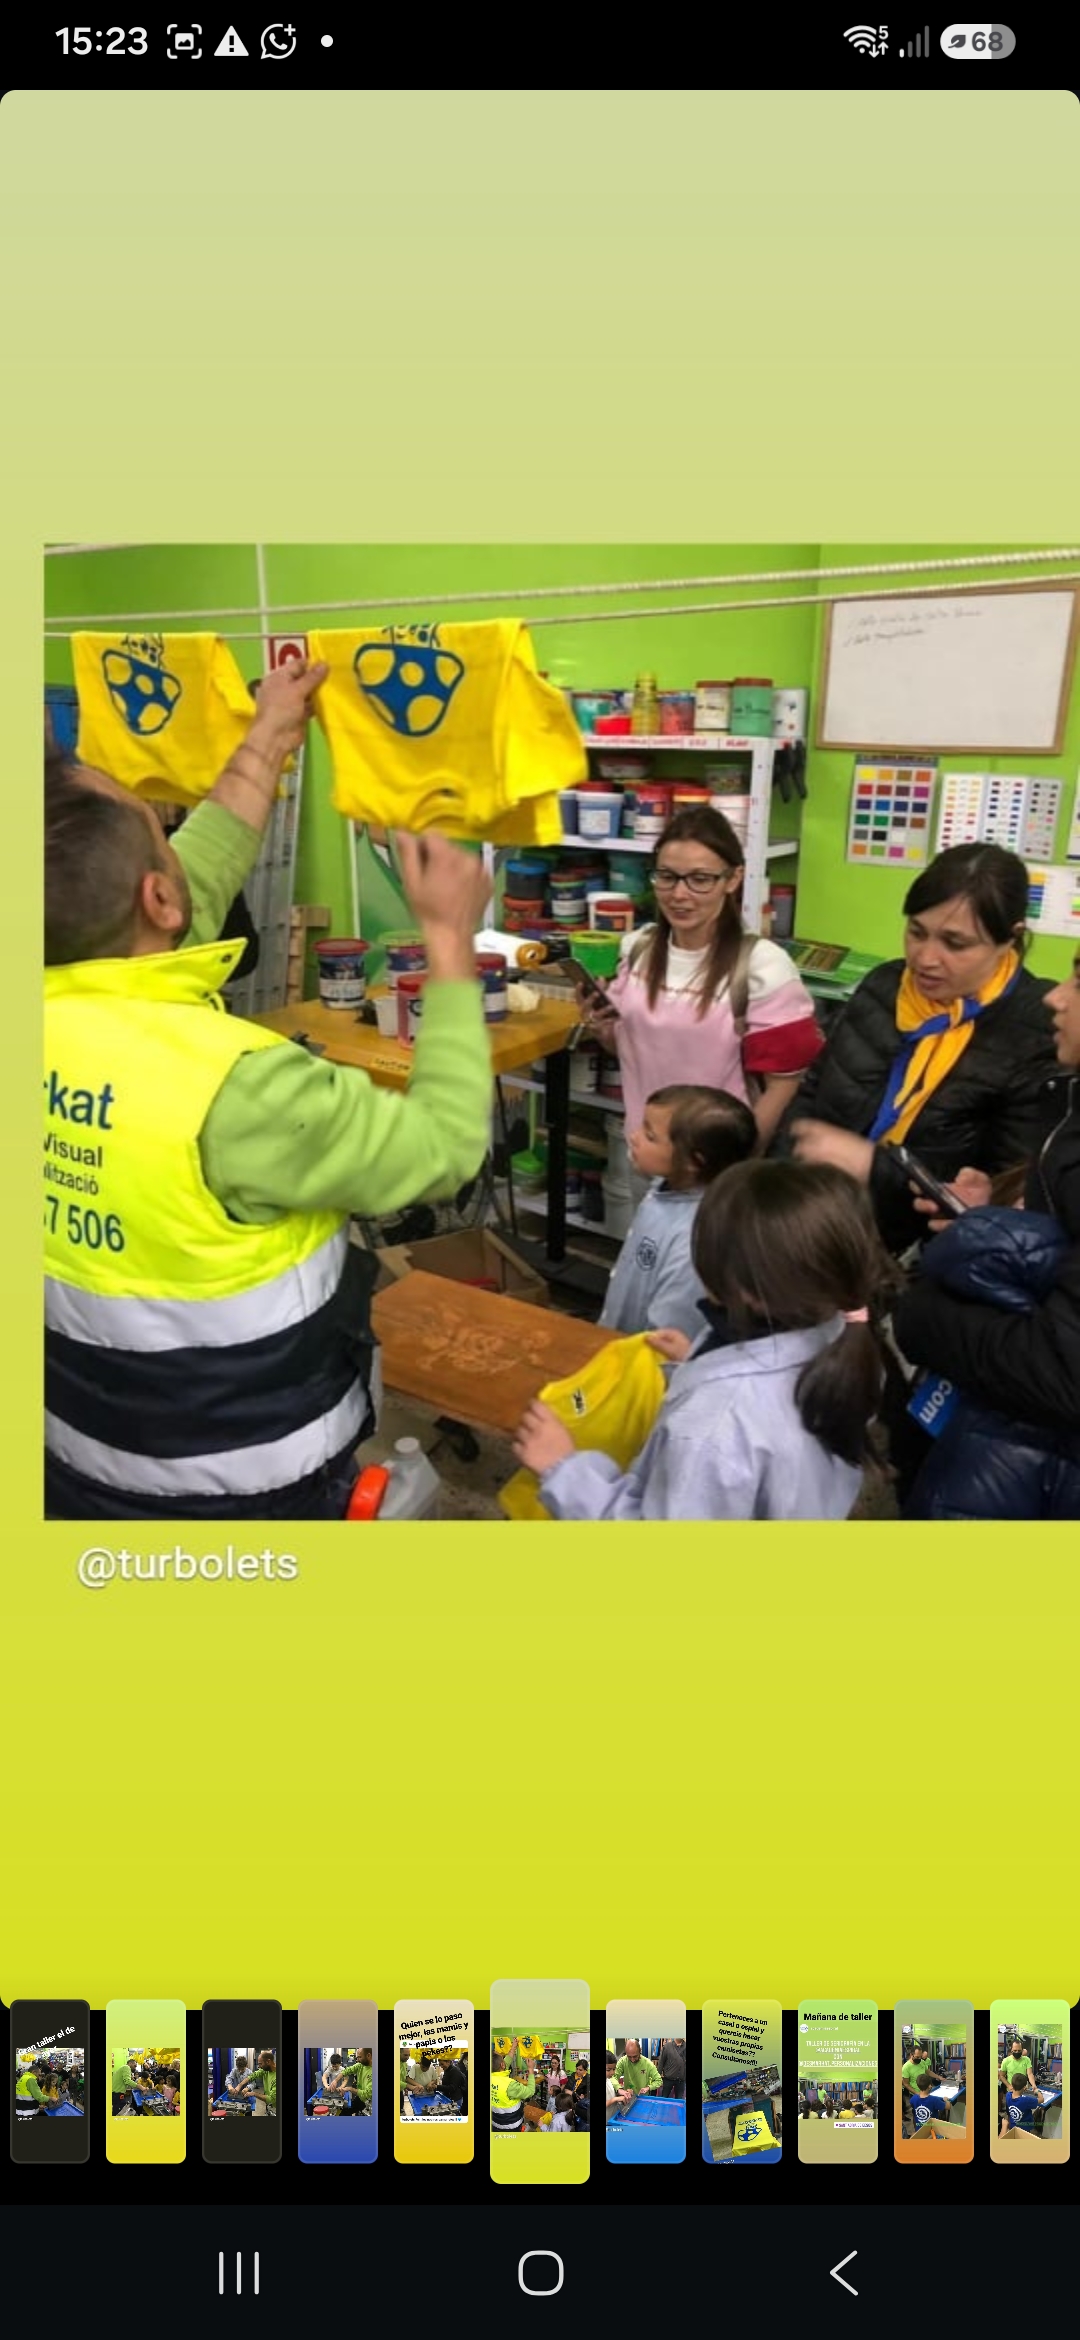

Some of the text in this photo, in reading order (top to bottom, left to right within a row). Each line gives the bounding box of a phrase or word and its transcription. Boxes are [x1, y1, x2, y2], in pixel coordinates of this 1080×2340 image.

[44, 1070, 114, 1130] kat
[44, 1195, 125, 1252] 7 506
[919, 1380, 953, 1424] com
